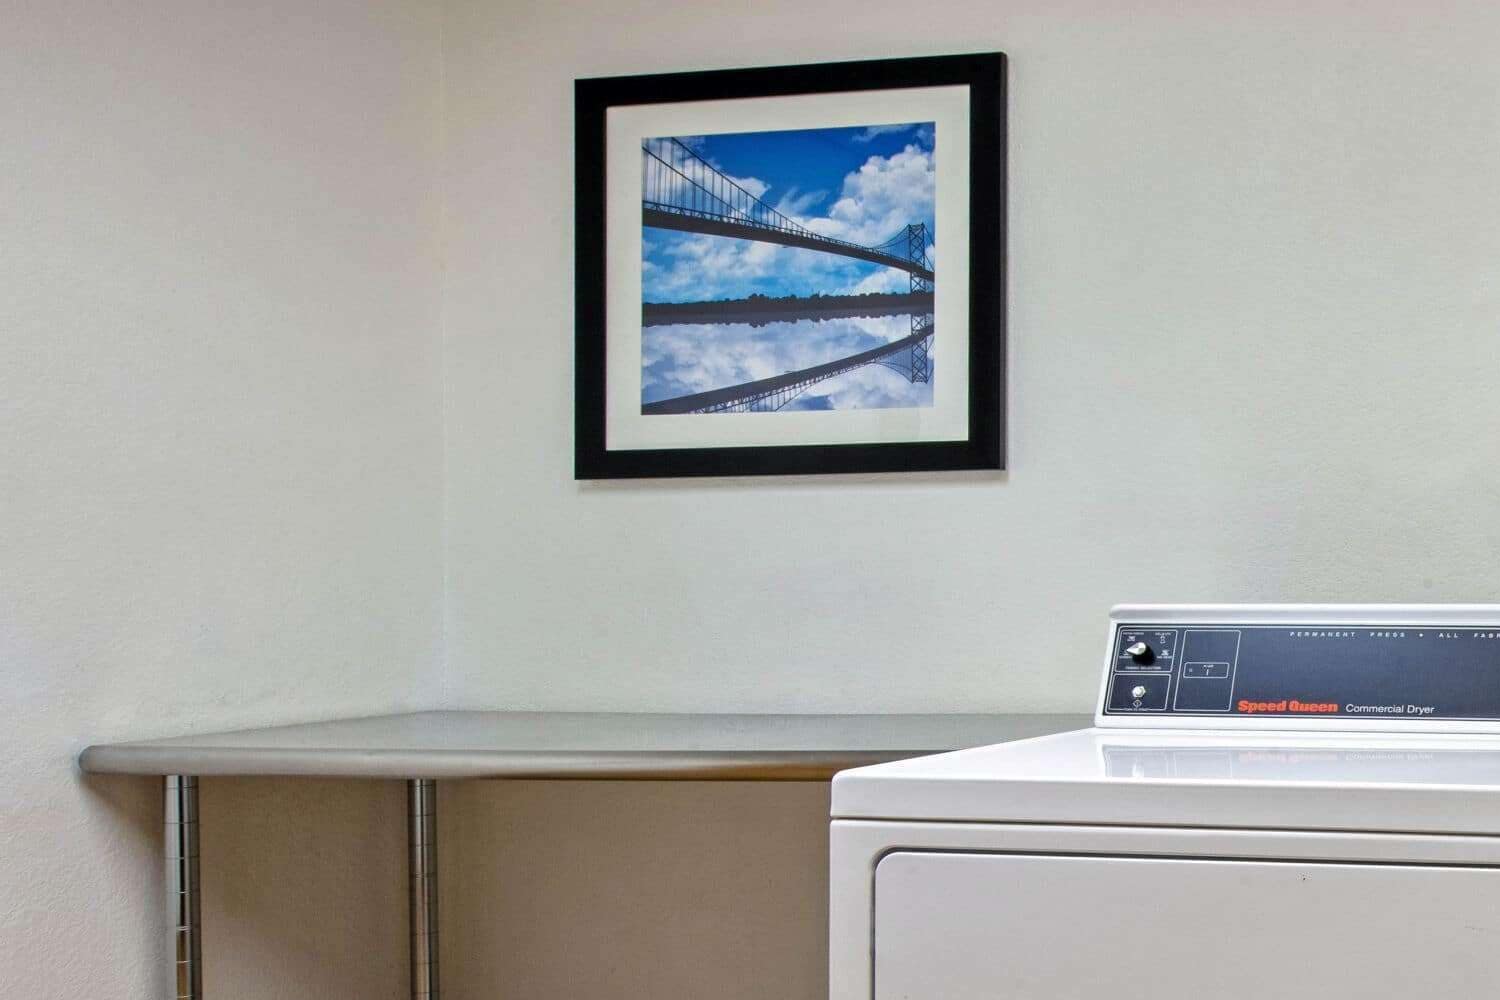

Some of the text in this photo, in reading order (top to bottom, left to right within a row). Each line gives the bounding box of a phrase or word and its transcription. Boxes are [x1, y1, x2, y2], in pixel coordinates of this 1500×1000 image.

[1238, 700, 1338, 713] Speed Queen
[1345, 703, 1436, 715] Commercial Dryer
